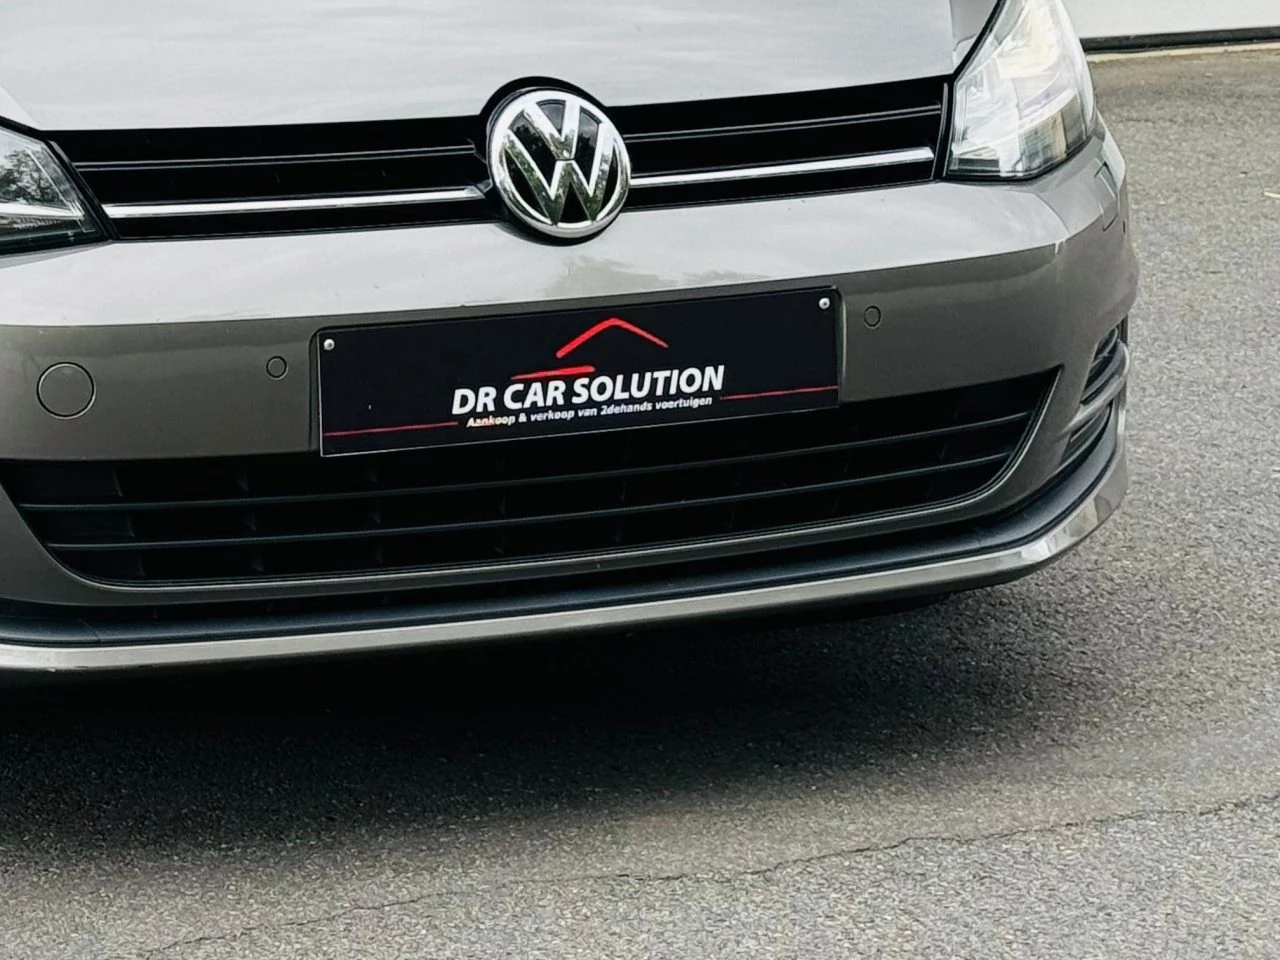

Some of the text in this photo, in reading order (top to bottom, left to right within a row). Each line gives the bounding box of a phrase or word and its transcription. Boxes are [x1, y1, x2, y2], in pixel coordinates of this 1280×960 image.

[494, 91, 624, 232] VW
[451, 364, 725, 415] DR CAR SOLUTION
[466, 396, 713, 428] Aankoop & verkoop van 2dehands voertuigen
